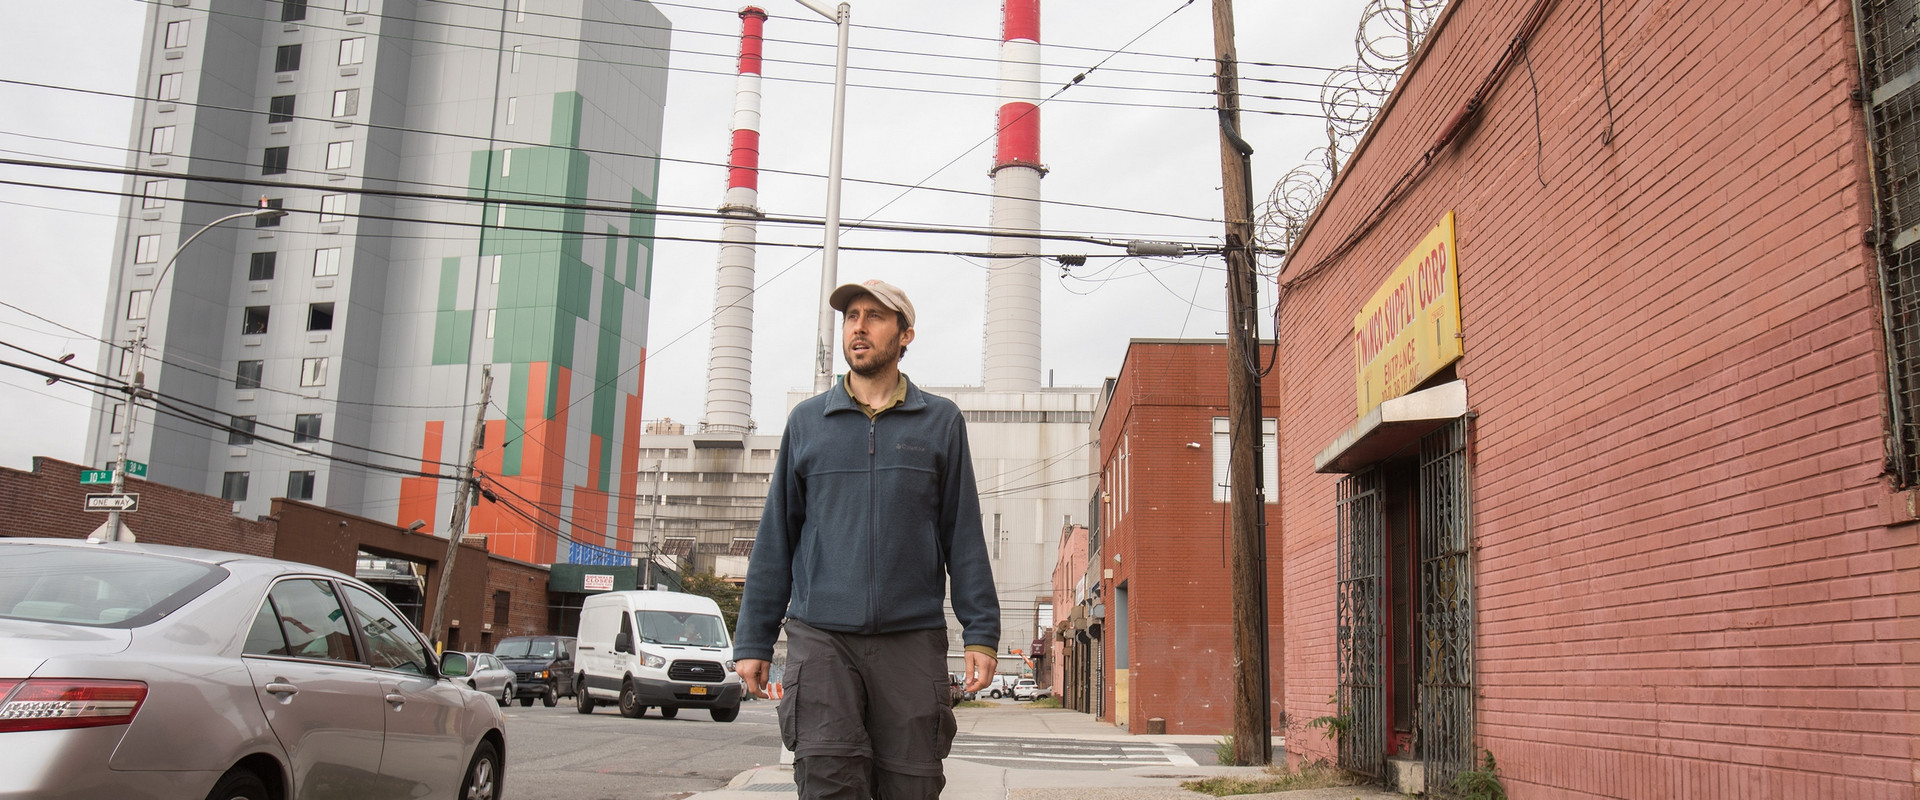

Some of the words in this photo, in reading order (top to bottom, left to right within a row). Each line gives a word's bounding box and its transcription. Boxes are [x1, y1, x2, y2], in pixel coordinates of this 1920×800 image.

[1356, 306, 1384, 374] TWINCO
[1385, 269, 1417, 345] SUPPLY
[1418, 241, 1447, 311] CORP
[1384, 337, 1416, 386] ENTRANCE
[89, 472, 98, 483] 10
